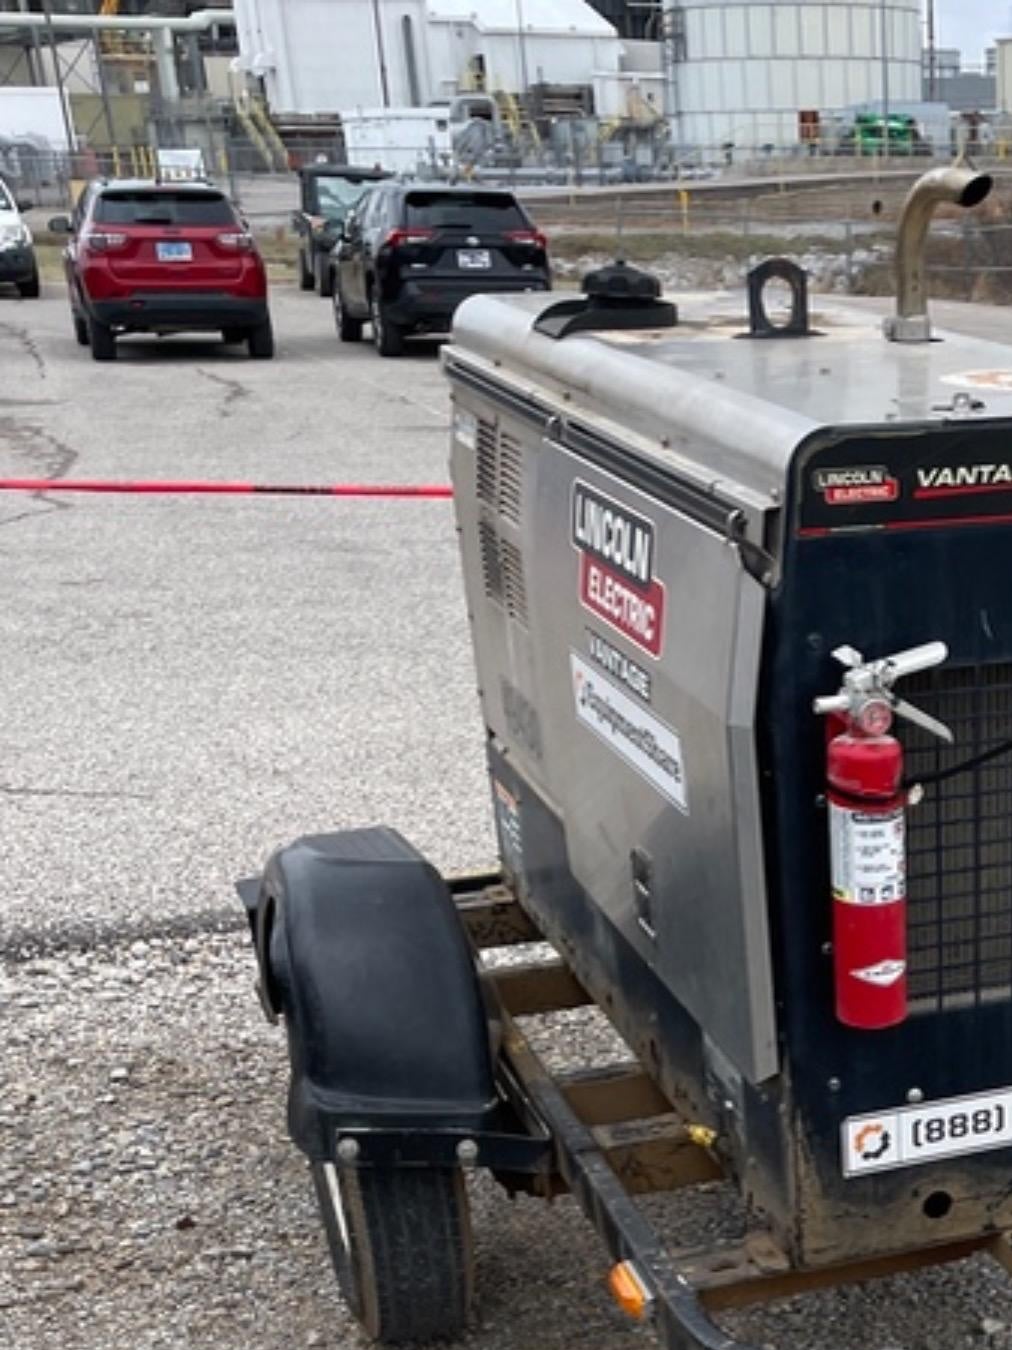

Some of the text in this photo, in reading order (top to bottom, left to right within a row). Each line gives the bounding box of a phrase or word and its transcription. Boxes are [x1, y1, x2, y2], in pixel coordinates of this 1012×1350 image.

[818, 470, 884, 487] LINCOLN
[575, 493, 650, 582] LINCOLN
[587, 564, 656, 641] ELECTRIC
[912, 1105, 1005, 1148] (888)
